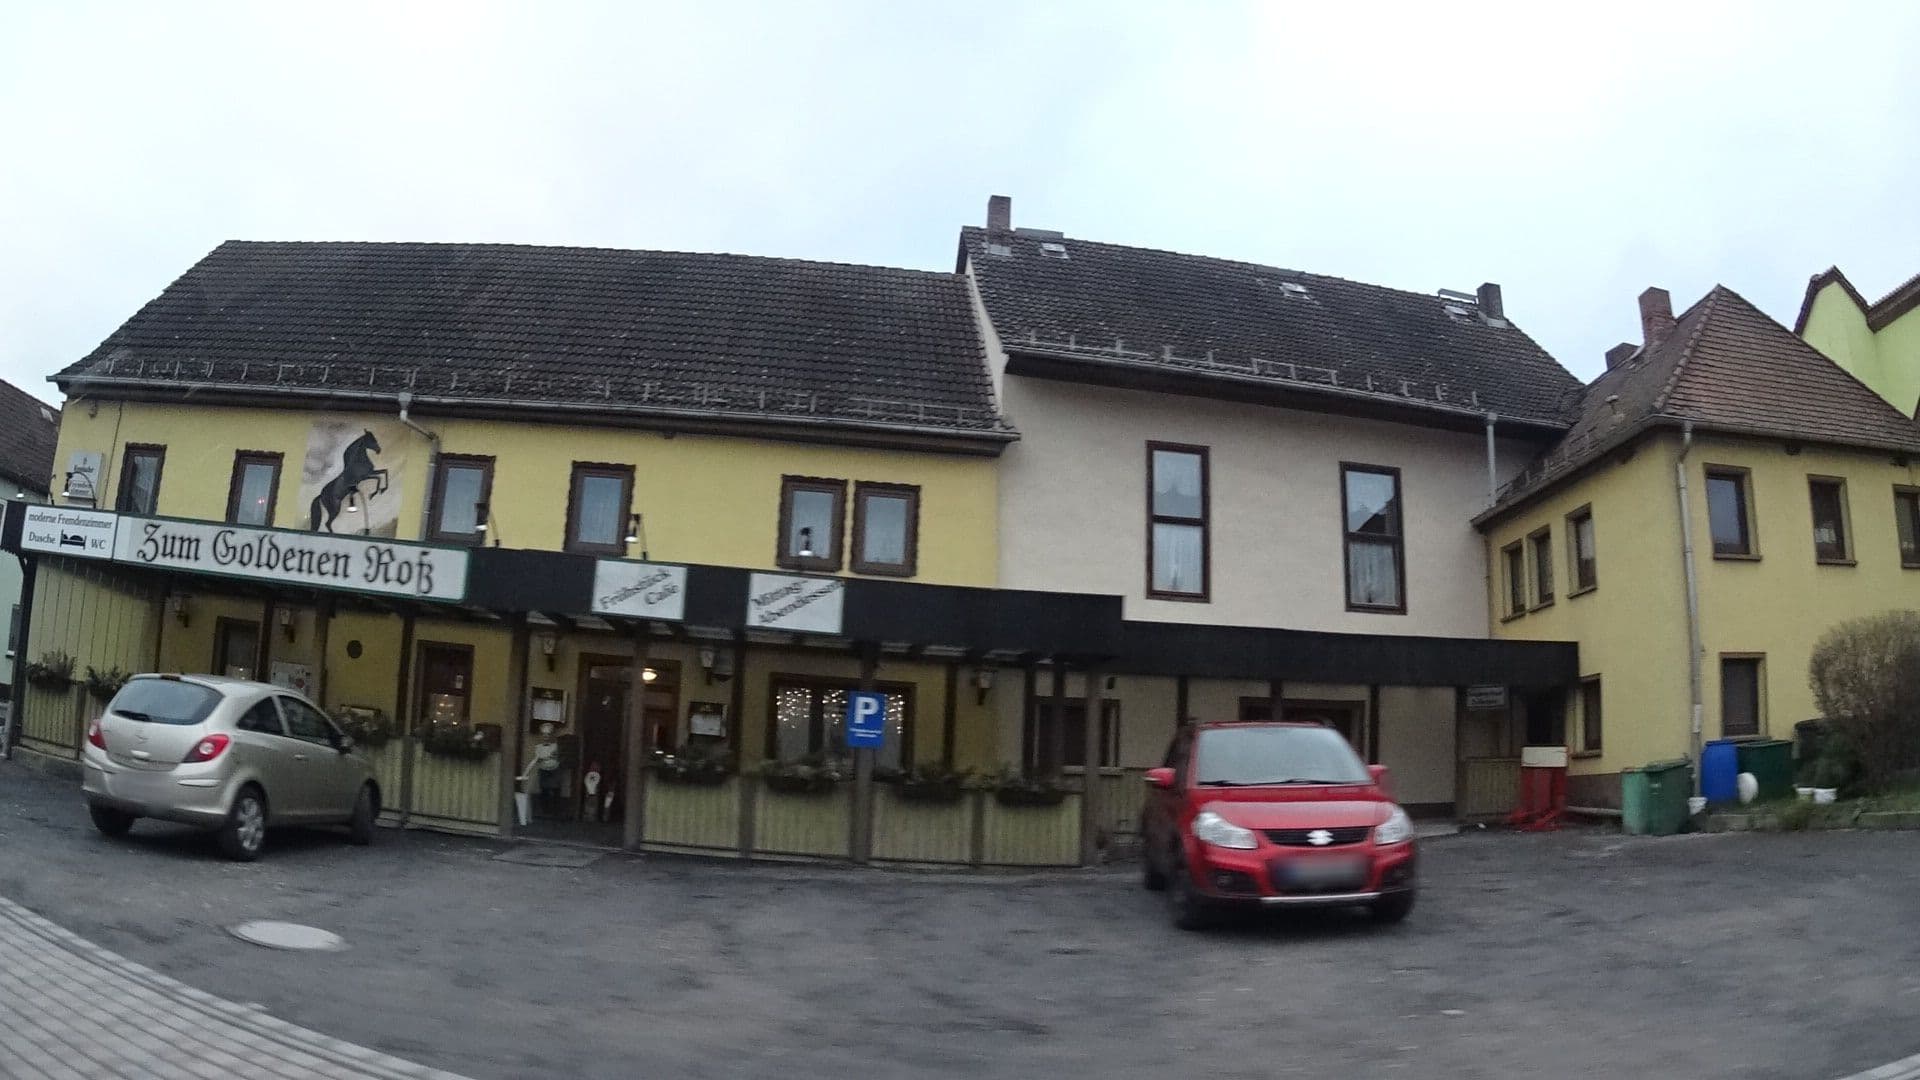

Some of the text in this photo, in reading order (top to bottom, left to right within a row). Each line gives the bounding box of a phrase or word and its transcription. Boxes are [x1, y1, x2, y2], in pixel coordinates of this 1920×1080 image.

[29, 512, 112, 529] moderne Fremdenzimmer
[28, 531, 107, 549] Dusche WC
[137, 524, 434, 597] Zum Goldenen Roß
[854, 696, 879, 724] P
